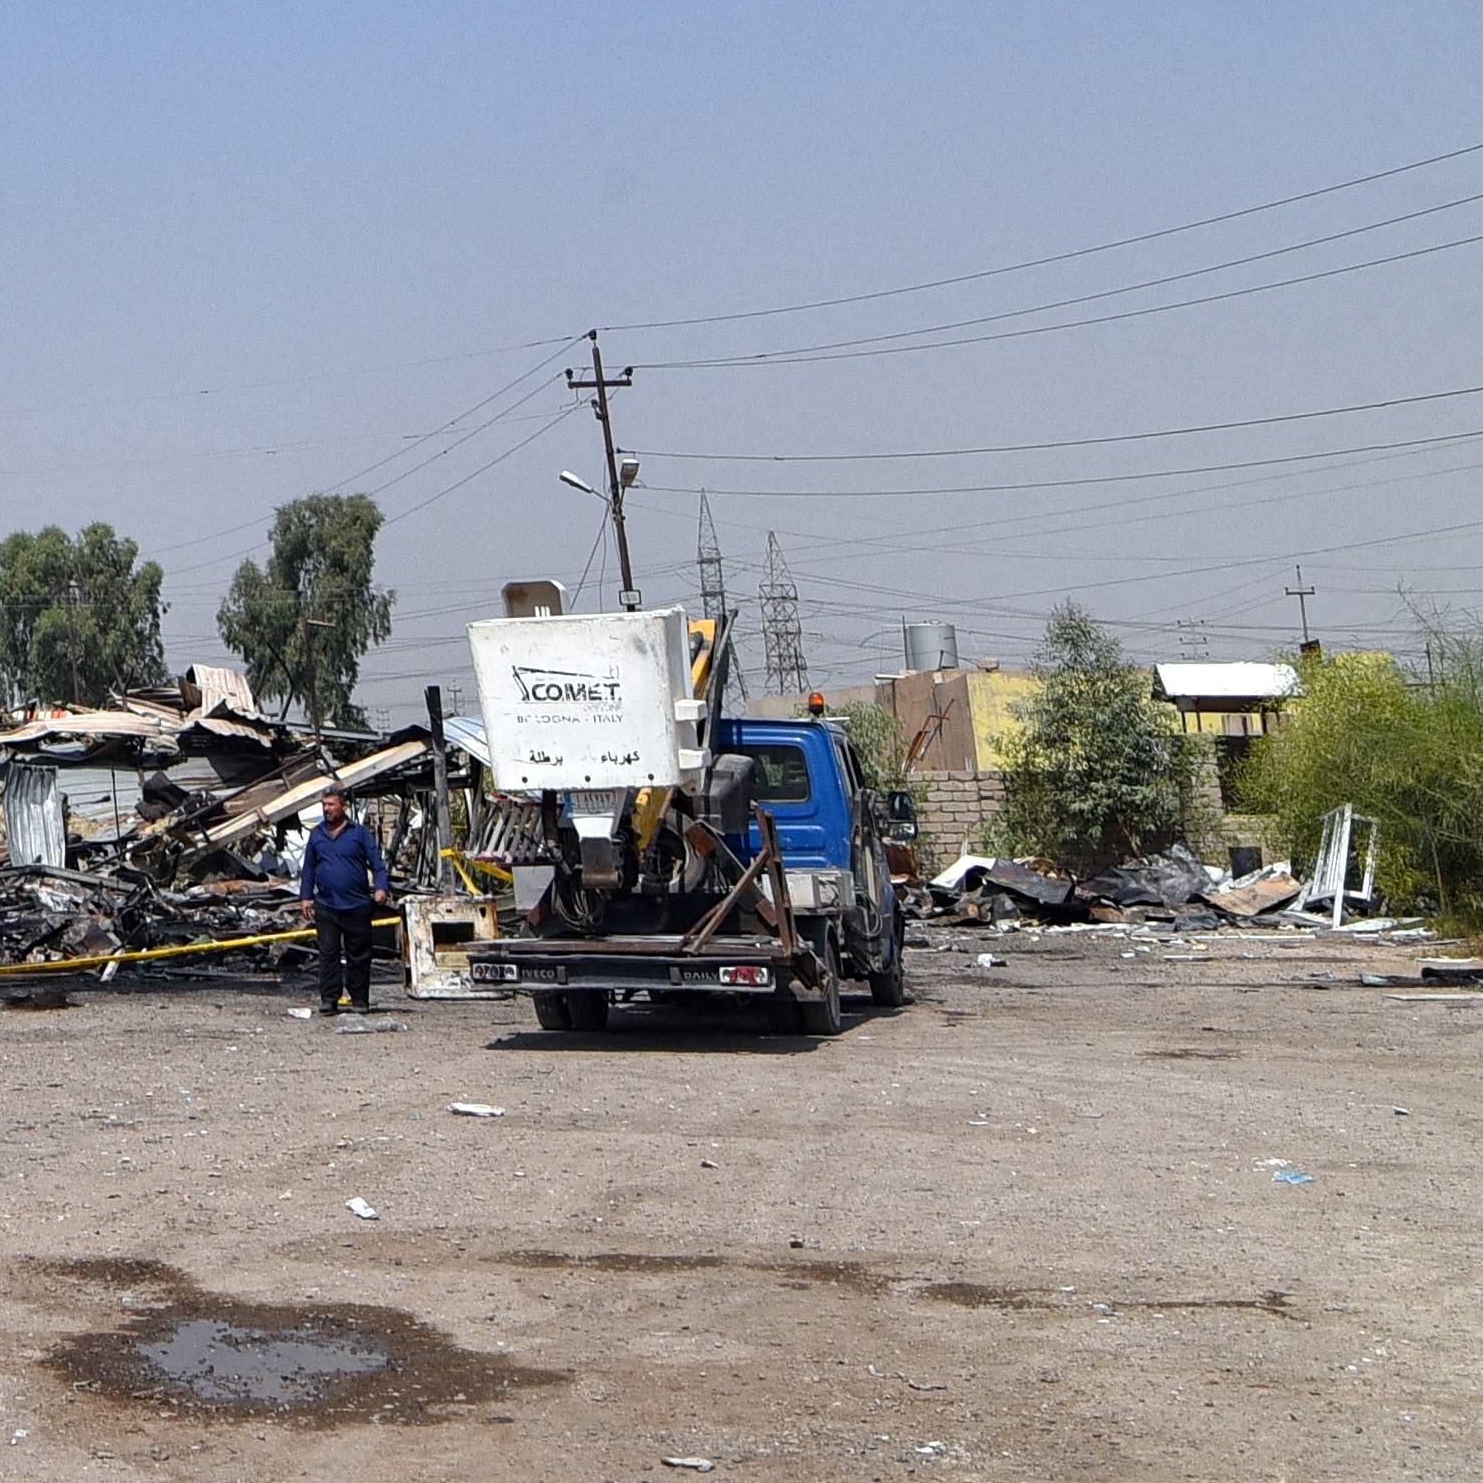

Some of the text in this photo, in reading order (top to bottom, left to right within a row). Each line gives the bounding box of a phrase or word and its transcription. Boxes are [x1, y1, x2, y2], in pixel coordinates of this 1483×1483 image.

[593, 715, 623, 723] ITALY
[601, 750, 640, 765] كهرباء
[521, 969, 556, 979] IVECO
[683, 971, 719, 981] DAILY
